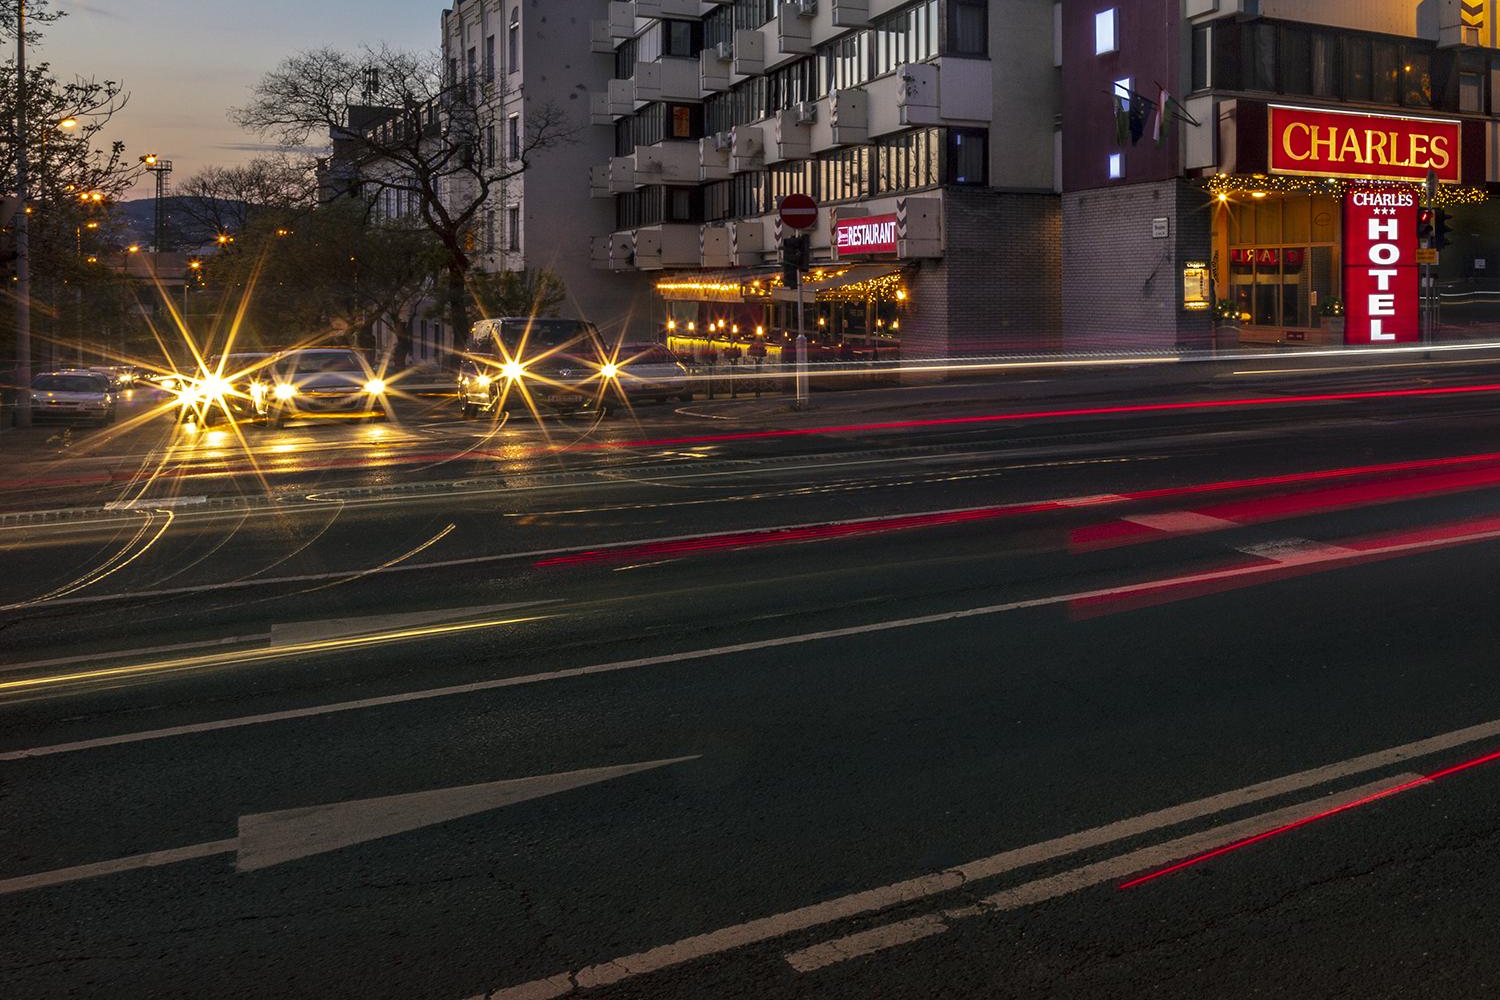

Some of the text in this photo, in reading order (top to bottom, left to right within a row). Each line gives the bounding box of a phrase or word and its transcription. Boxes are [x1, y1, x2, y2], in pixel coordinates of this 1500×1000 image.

[1282, 121, 1450, 170] CHARLES
[1353, 192, 1414, 207] CHARLES
[848, 221, 897, 246] RESTAURANT
[1368, 218, 1401, 341] HOTEL
